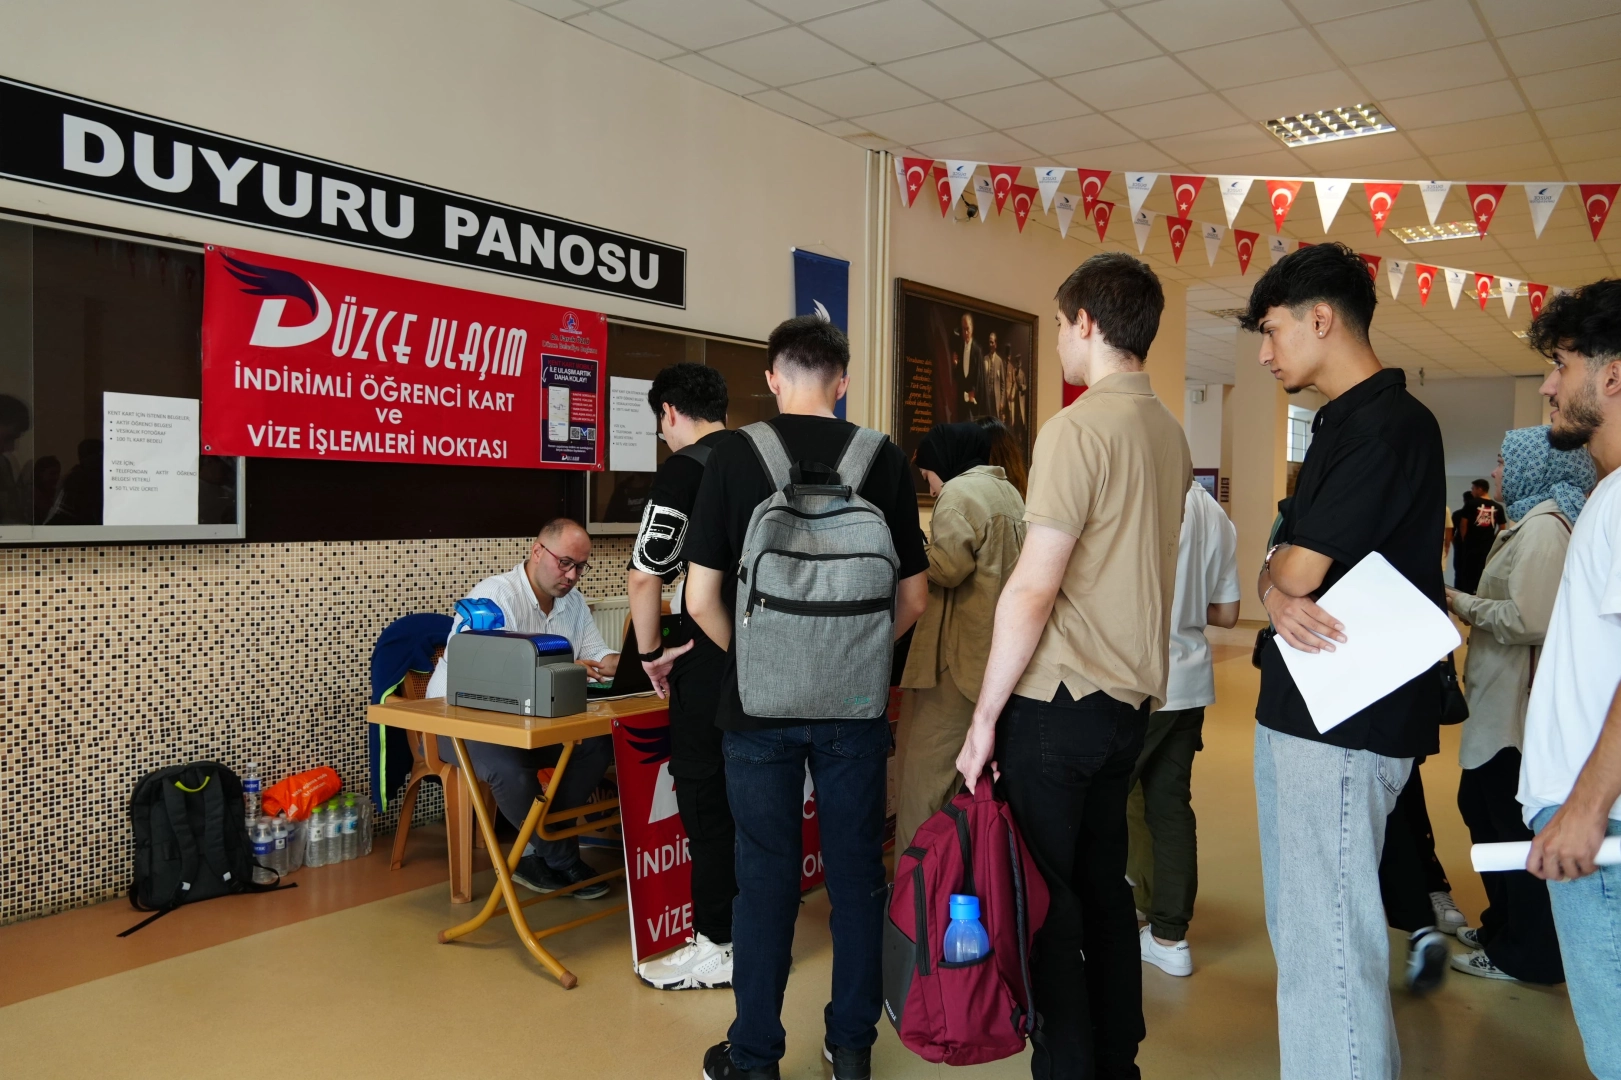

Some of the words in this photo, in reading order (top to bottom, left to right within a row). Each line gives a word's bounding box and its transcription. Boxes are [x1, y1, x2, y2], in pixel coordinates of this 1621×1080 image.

[63, 113, 414, 239] DUYURU
[445, 204, 659, 290] PANOSU
[249, 281, 418, 365] DÜZCE
[425, 317, 528, 381] ULAŞIM
[235, 361, 352, 398] İNDİRİMLİ
[360, 374, 461, 408] ÖĞRENCİ
[468, 389, 515, 412] KART
[375, 407, 403, 425] ve
[247, 420, 301, 449] VİZE
[309, 423, 415, 455] İŞLEMLERİ
[422, 435, 507, 459] NOKTASI
[647, 902, 693, 943] VİZE
